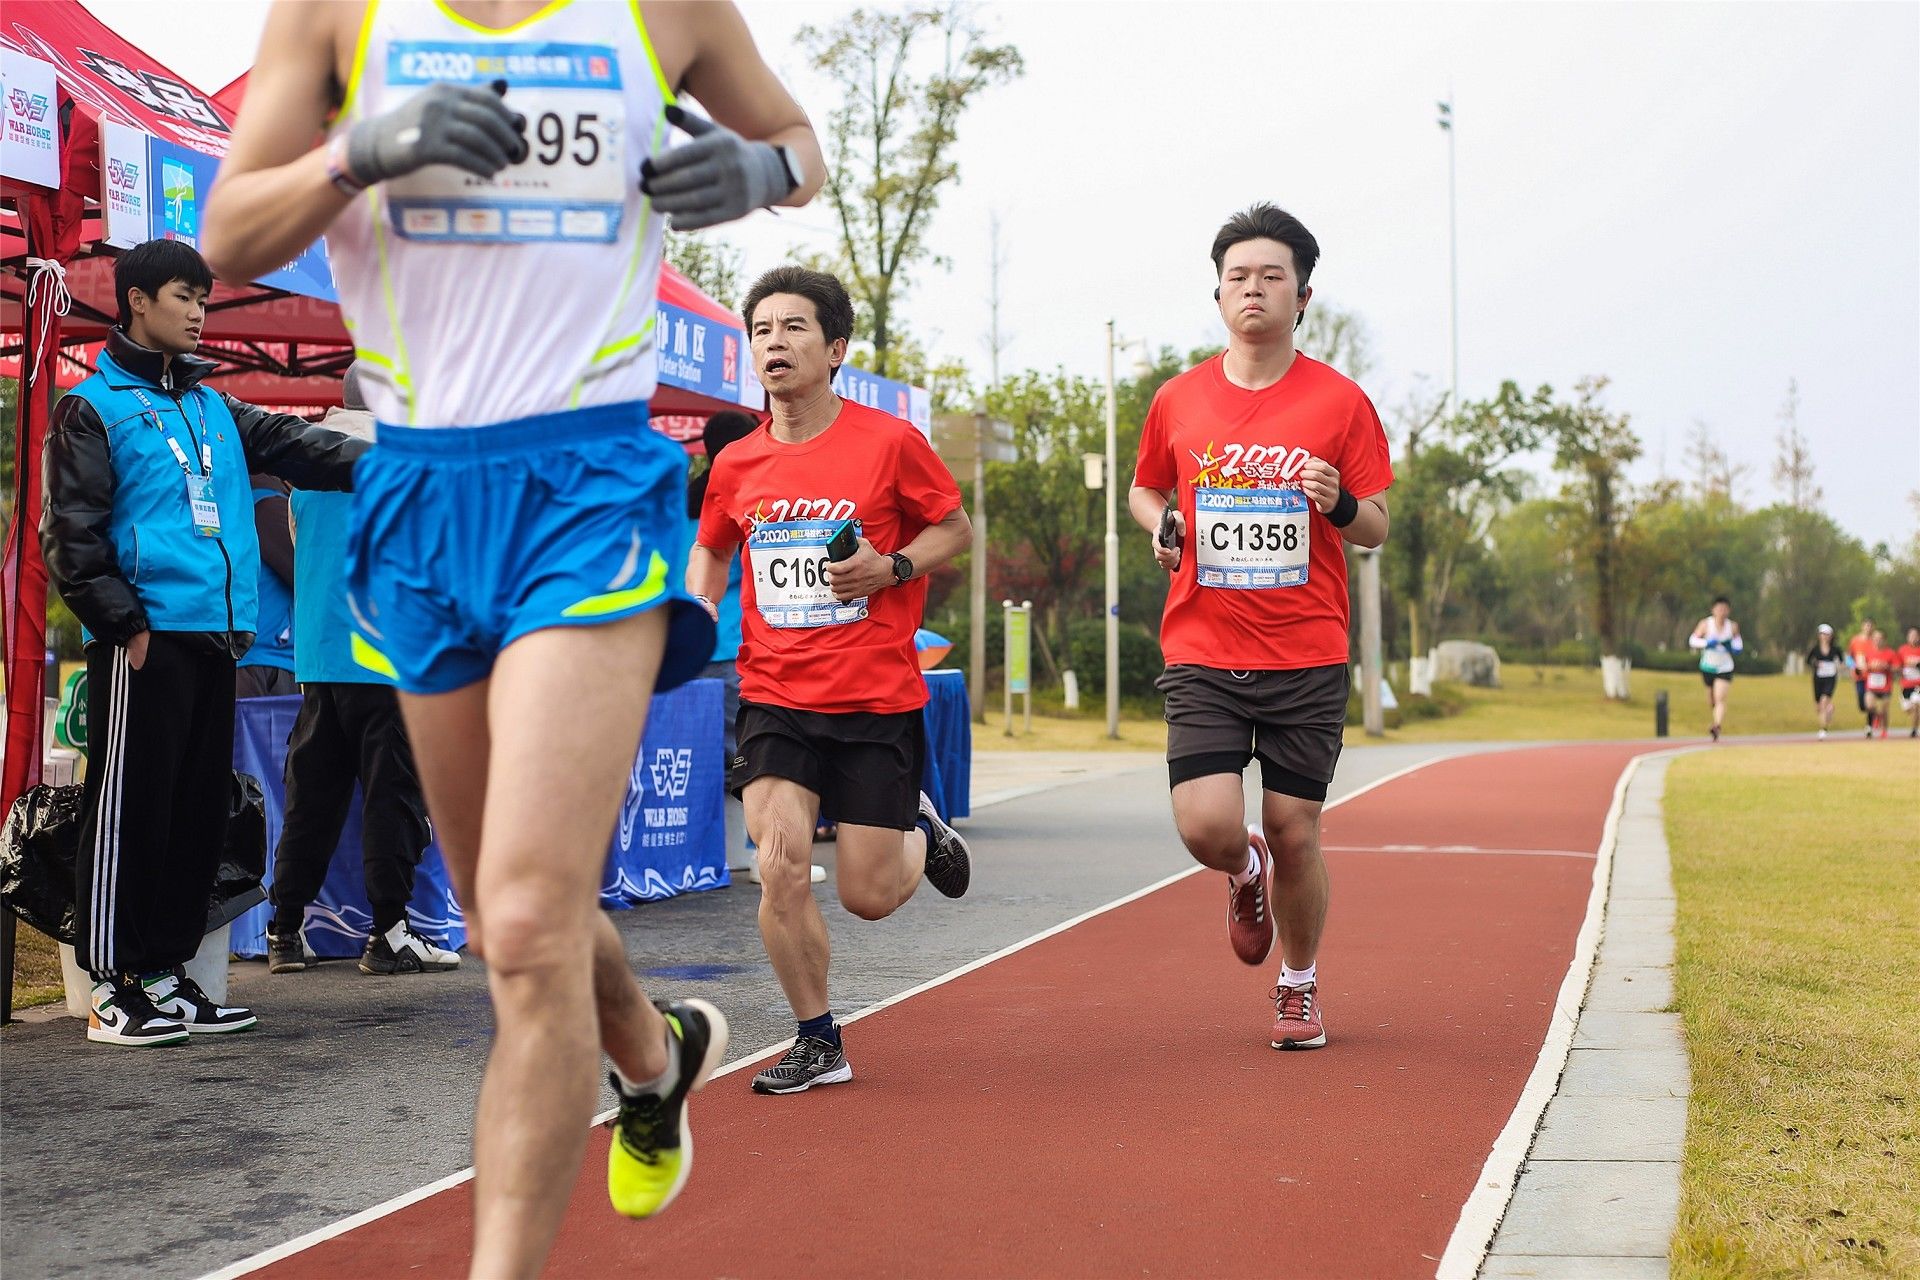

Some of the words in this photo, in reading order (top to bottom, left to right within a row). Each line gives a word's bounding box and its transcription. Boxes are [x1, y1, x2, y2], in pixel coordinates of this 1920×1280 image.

[8, 119, 25, 133] WAR
[25, 123, 51, 141] HORSE
[120, 192, 141, 208] HORSE
[677, 357, 702, 384] Station
[1208, 495, 1235, 508] 2020
[761, 529, 790, 543] 2020
[1210, 522, 1298, 551] C1358
[769, 557, 831, 589] C166
[643, 808, 666, 828] WAR
